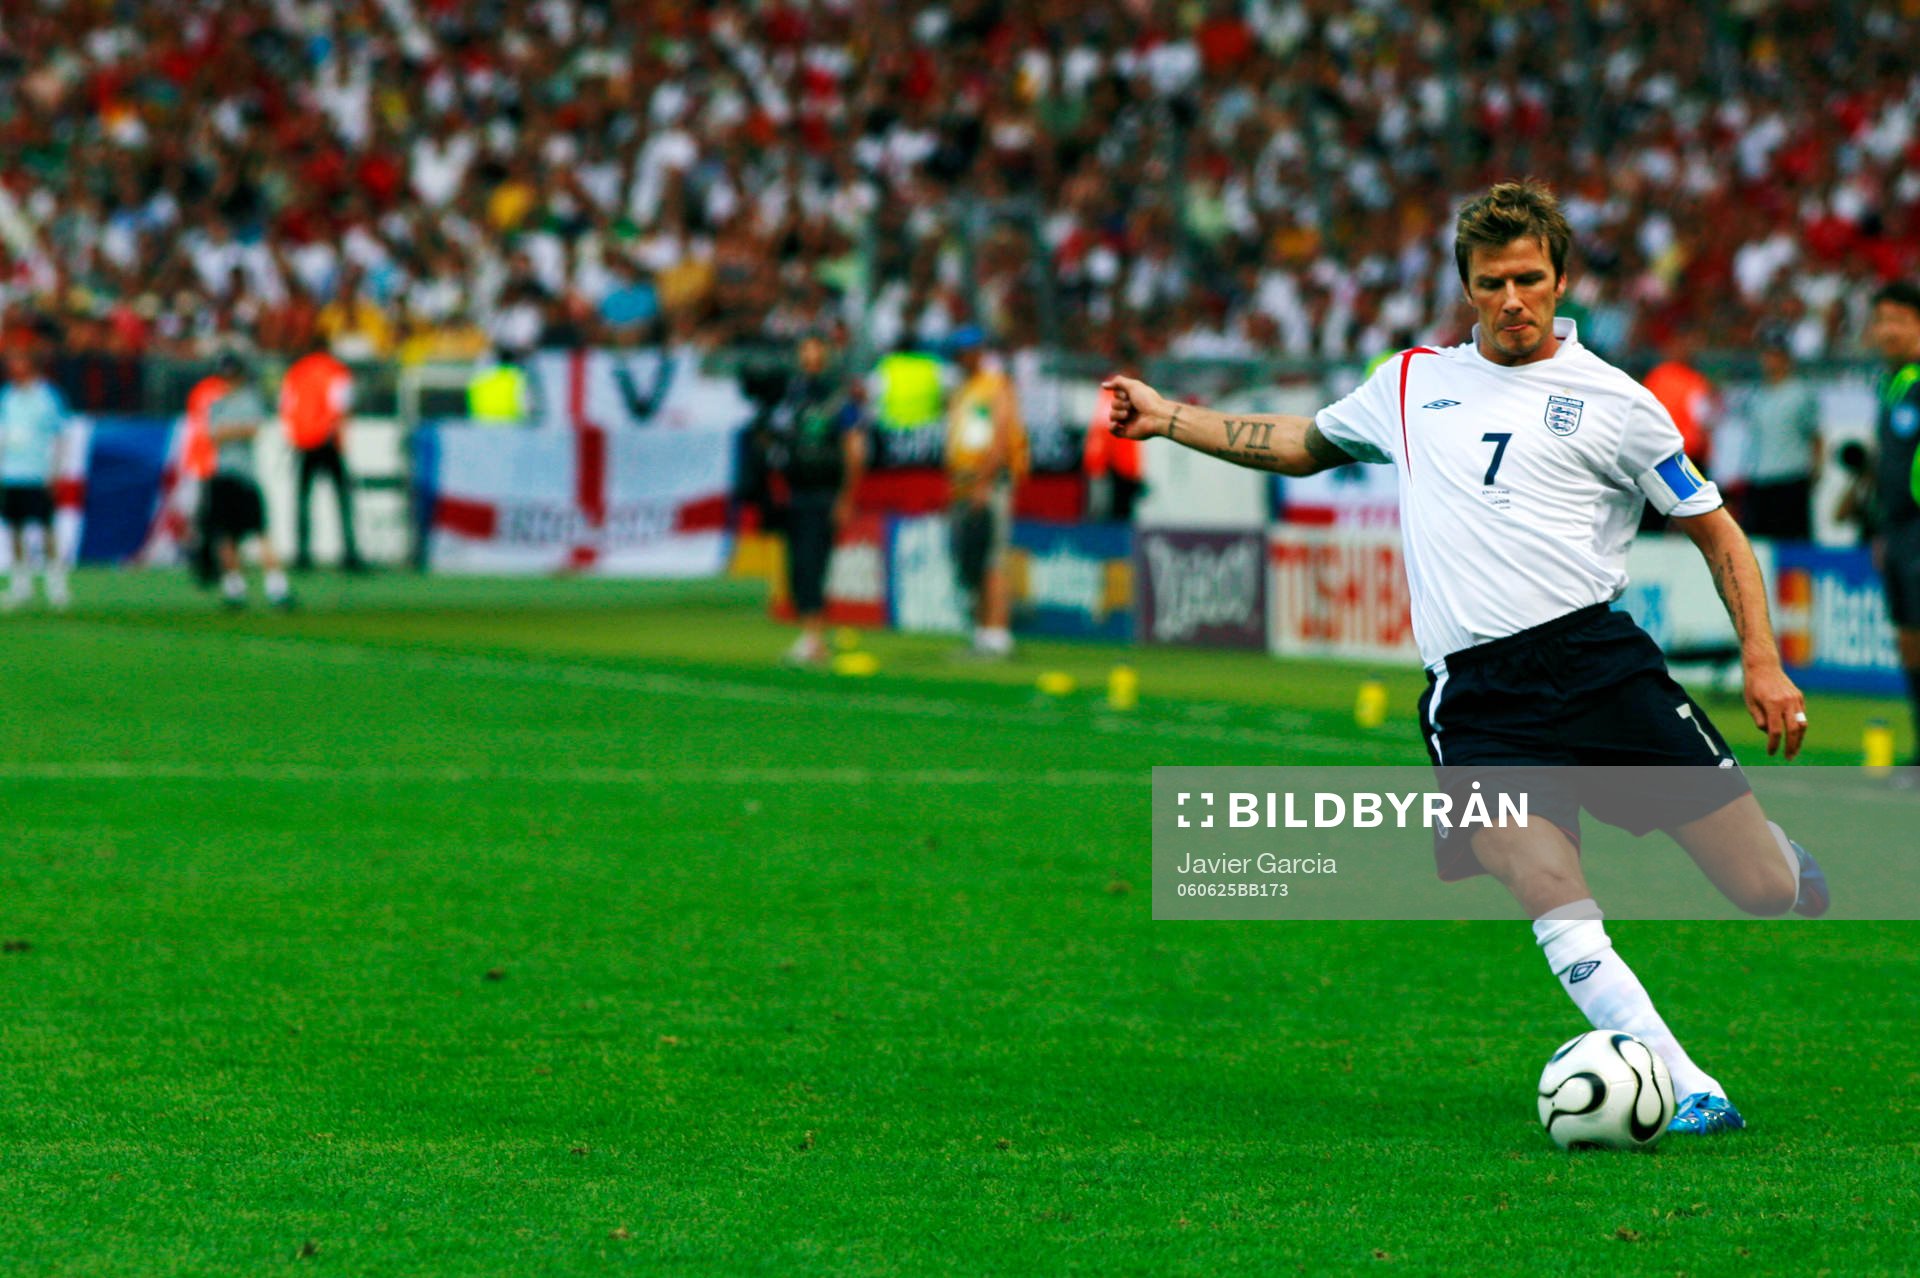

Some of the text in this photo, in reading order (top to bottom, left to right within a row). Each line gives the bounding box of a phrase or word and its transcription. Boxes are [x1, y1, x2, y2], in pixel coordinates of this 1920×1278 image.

[1224, 420, 1275, 449] VII
[1481, 433, 1512, 486] 7
[1676, 703, 1719, 756] 7
